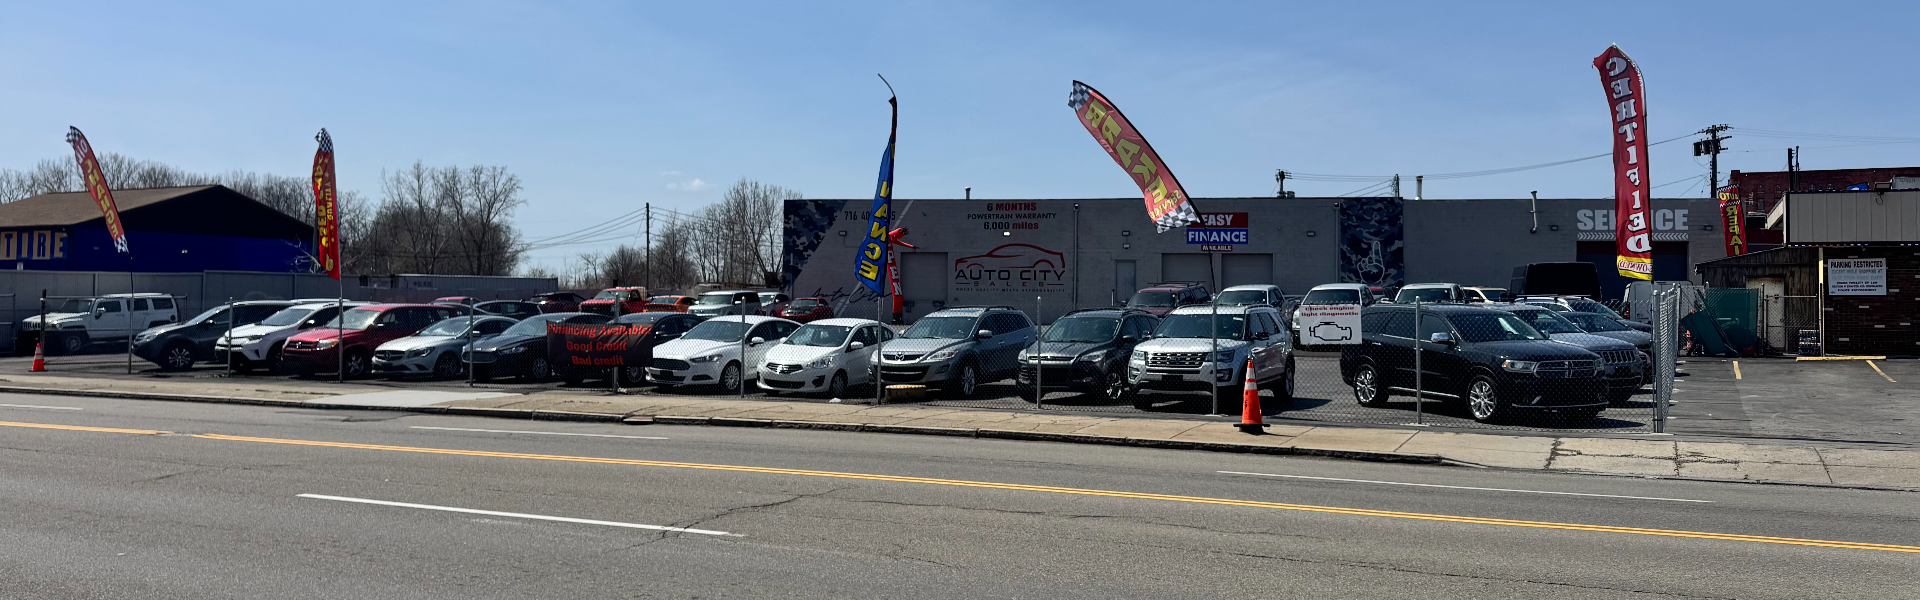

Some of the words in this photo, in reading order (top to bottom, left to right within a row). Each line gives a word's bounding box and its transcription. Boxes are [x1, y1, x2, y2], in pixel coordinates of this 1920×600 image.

[986, 203, 993, 211] 6
[995, 202, 1037, 211] MONTHS
[844, 211, 858, 221] 716
[1201, 214, 1234, 226] EASY
[1576, 208, 1689, 231] SECE
[983, 222, 1010, 231] 6,000
[1012, 222, 1039, 230] miles
[1188, 231, 1247, 242] FINANCE
[0, 230, 68, 260] TIRE
[954, 269, 1011, 281] AUTO
[1019, 269, 1066, 281] CITY
[547, 323, 597, 339] Financing
[566, 341, 593, 352] Good
[596, 341, 627, 351] Credit
[571, 355, 592, 365] Bad
[594, 355, 624, 365] credit
